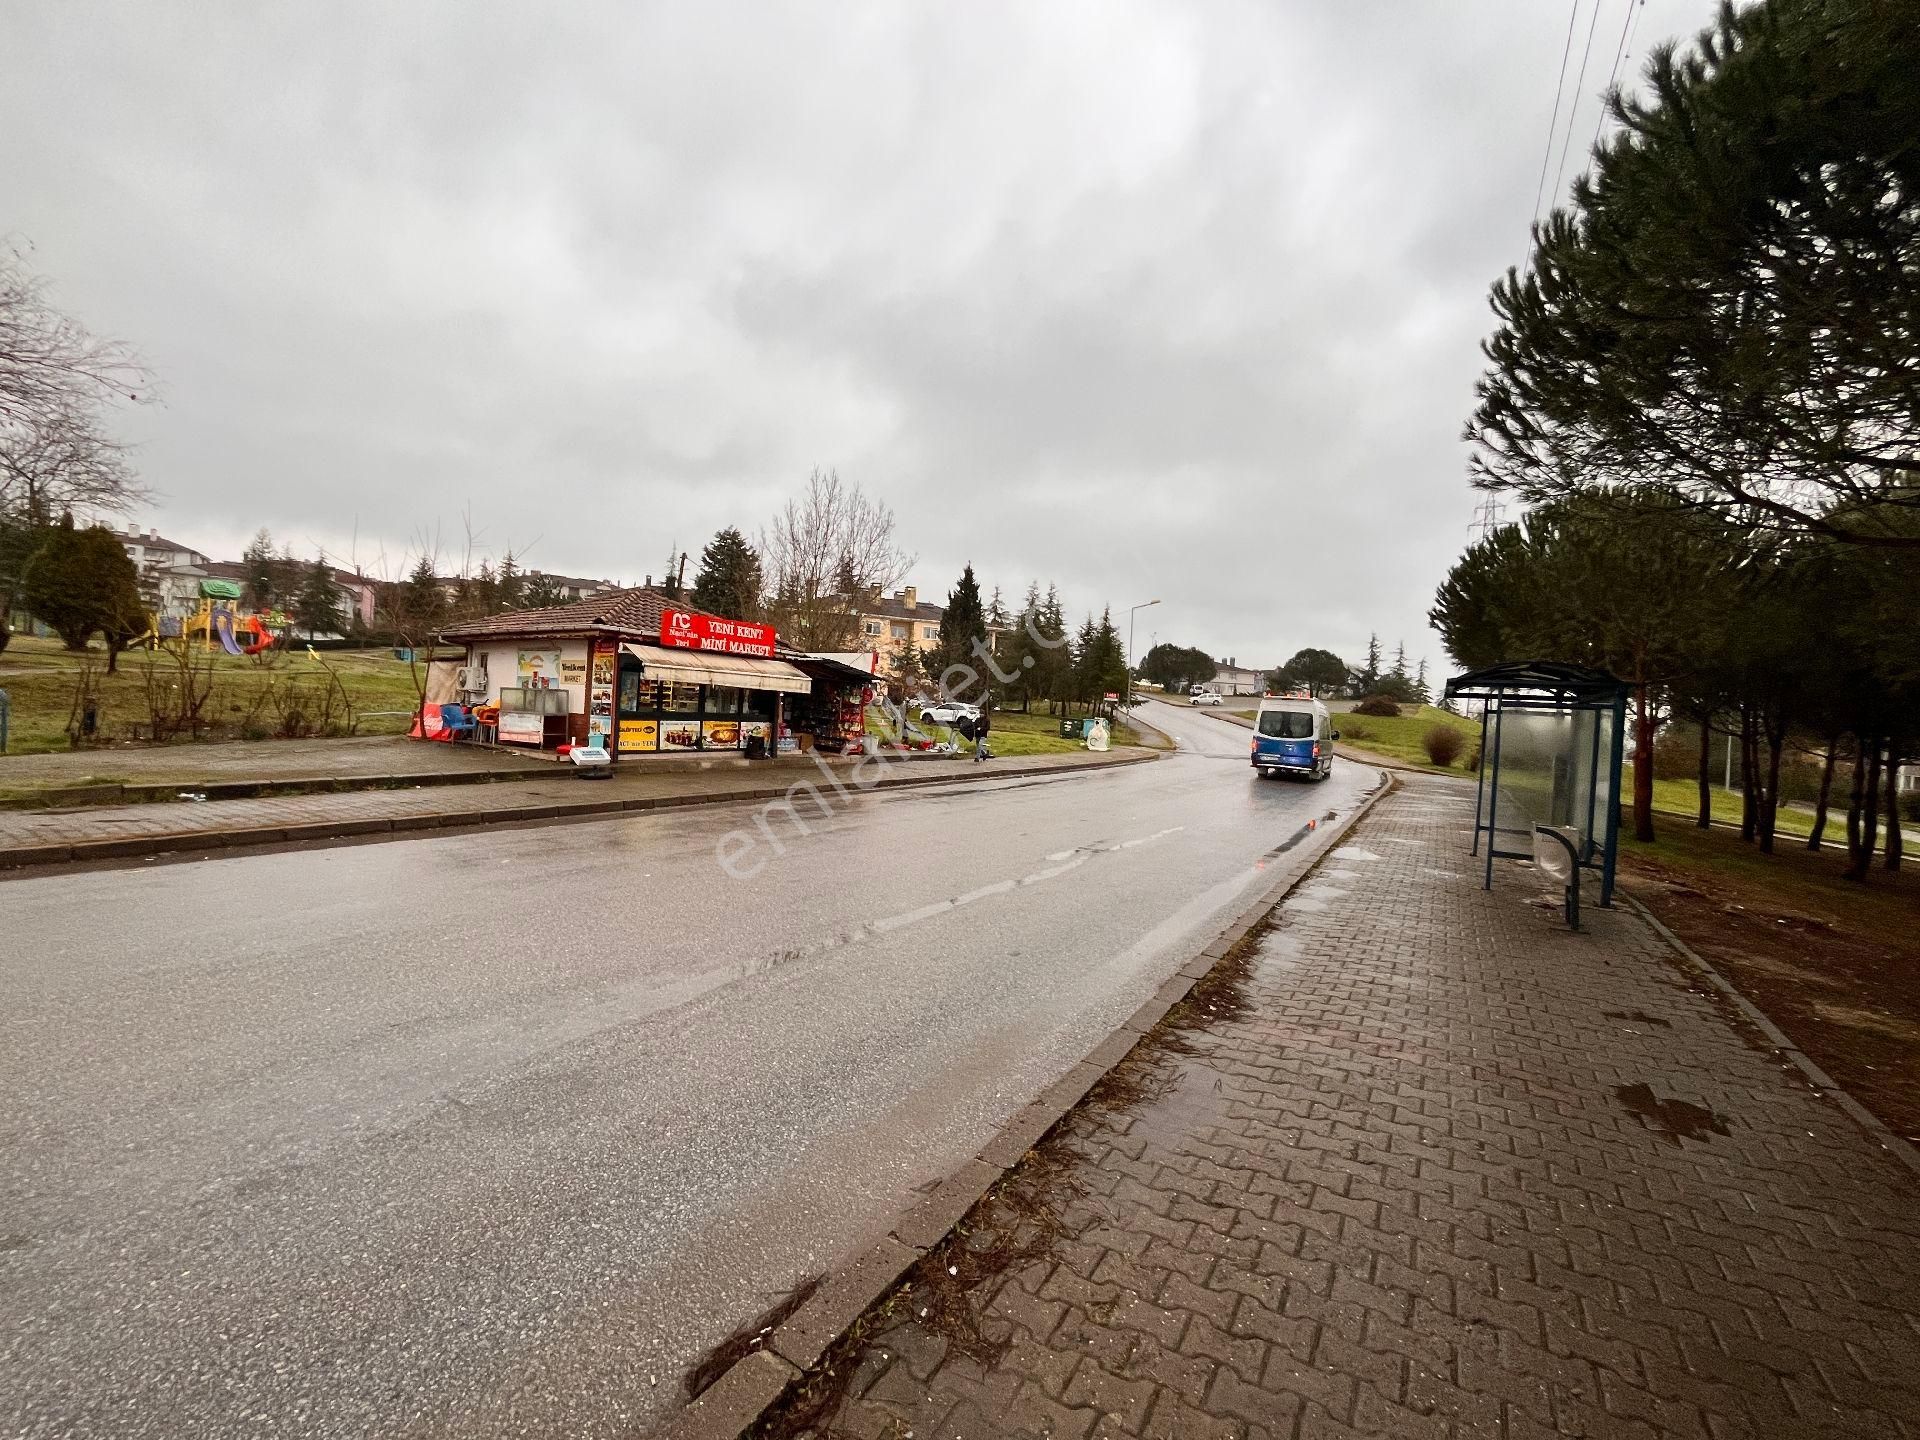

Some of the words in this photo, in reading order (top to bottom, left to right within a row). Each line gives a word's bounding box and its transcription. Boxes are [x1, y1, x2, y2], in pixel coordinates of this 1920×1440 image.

[708, 620, 735, 636] YENİ
[736, 625, 764, 640] KENT
[700, 635, 727, 651] MİNİ
[729, 640, 771, 657] MARKET
[564, 675, 582, 683] MARKET
